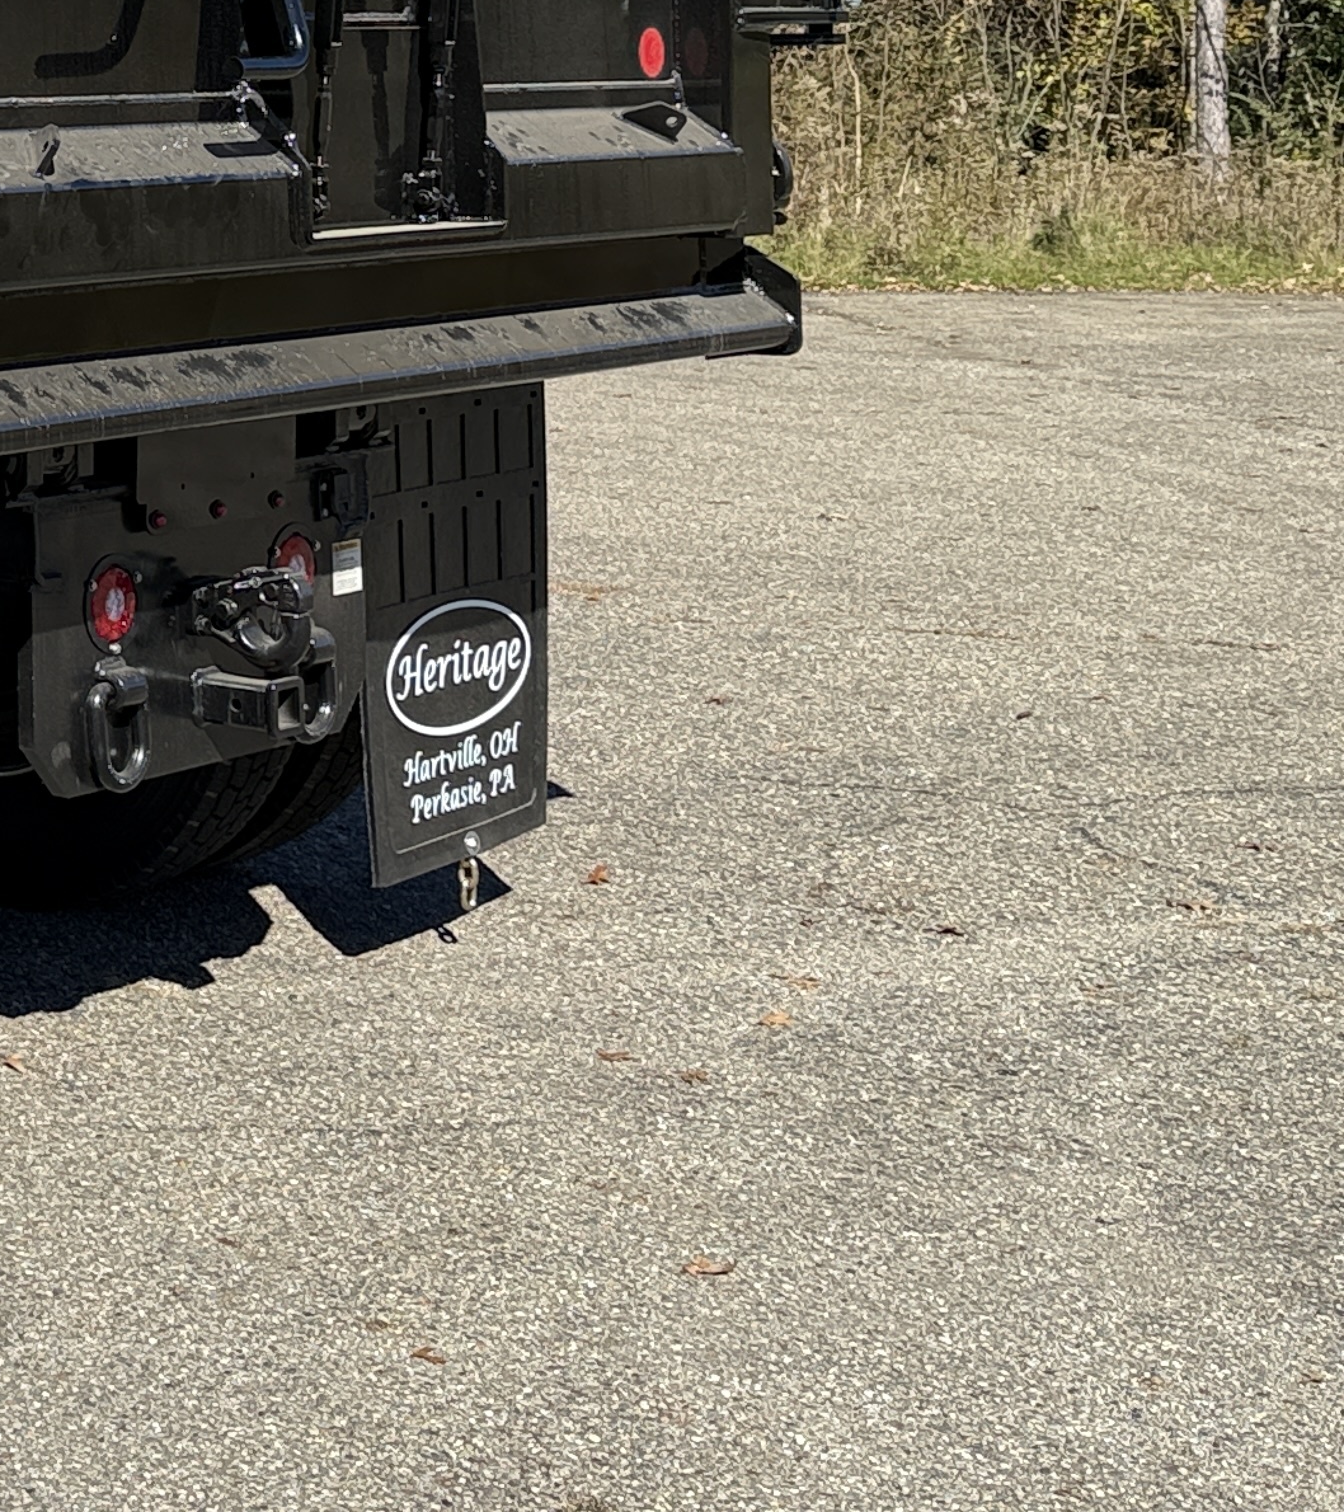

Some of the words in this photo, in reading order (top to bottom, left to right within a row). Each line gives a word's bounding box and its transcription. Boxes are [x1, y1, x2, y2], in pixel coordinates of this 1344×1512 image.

[396, 637, 522, 701] Heritage
[403, 734, 487, 787] Hartville,
[490, 721, 522, 759] OH
[410, 777, 487, 824] Perkasie,
[489, 764, 516, 797] PA
